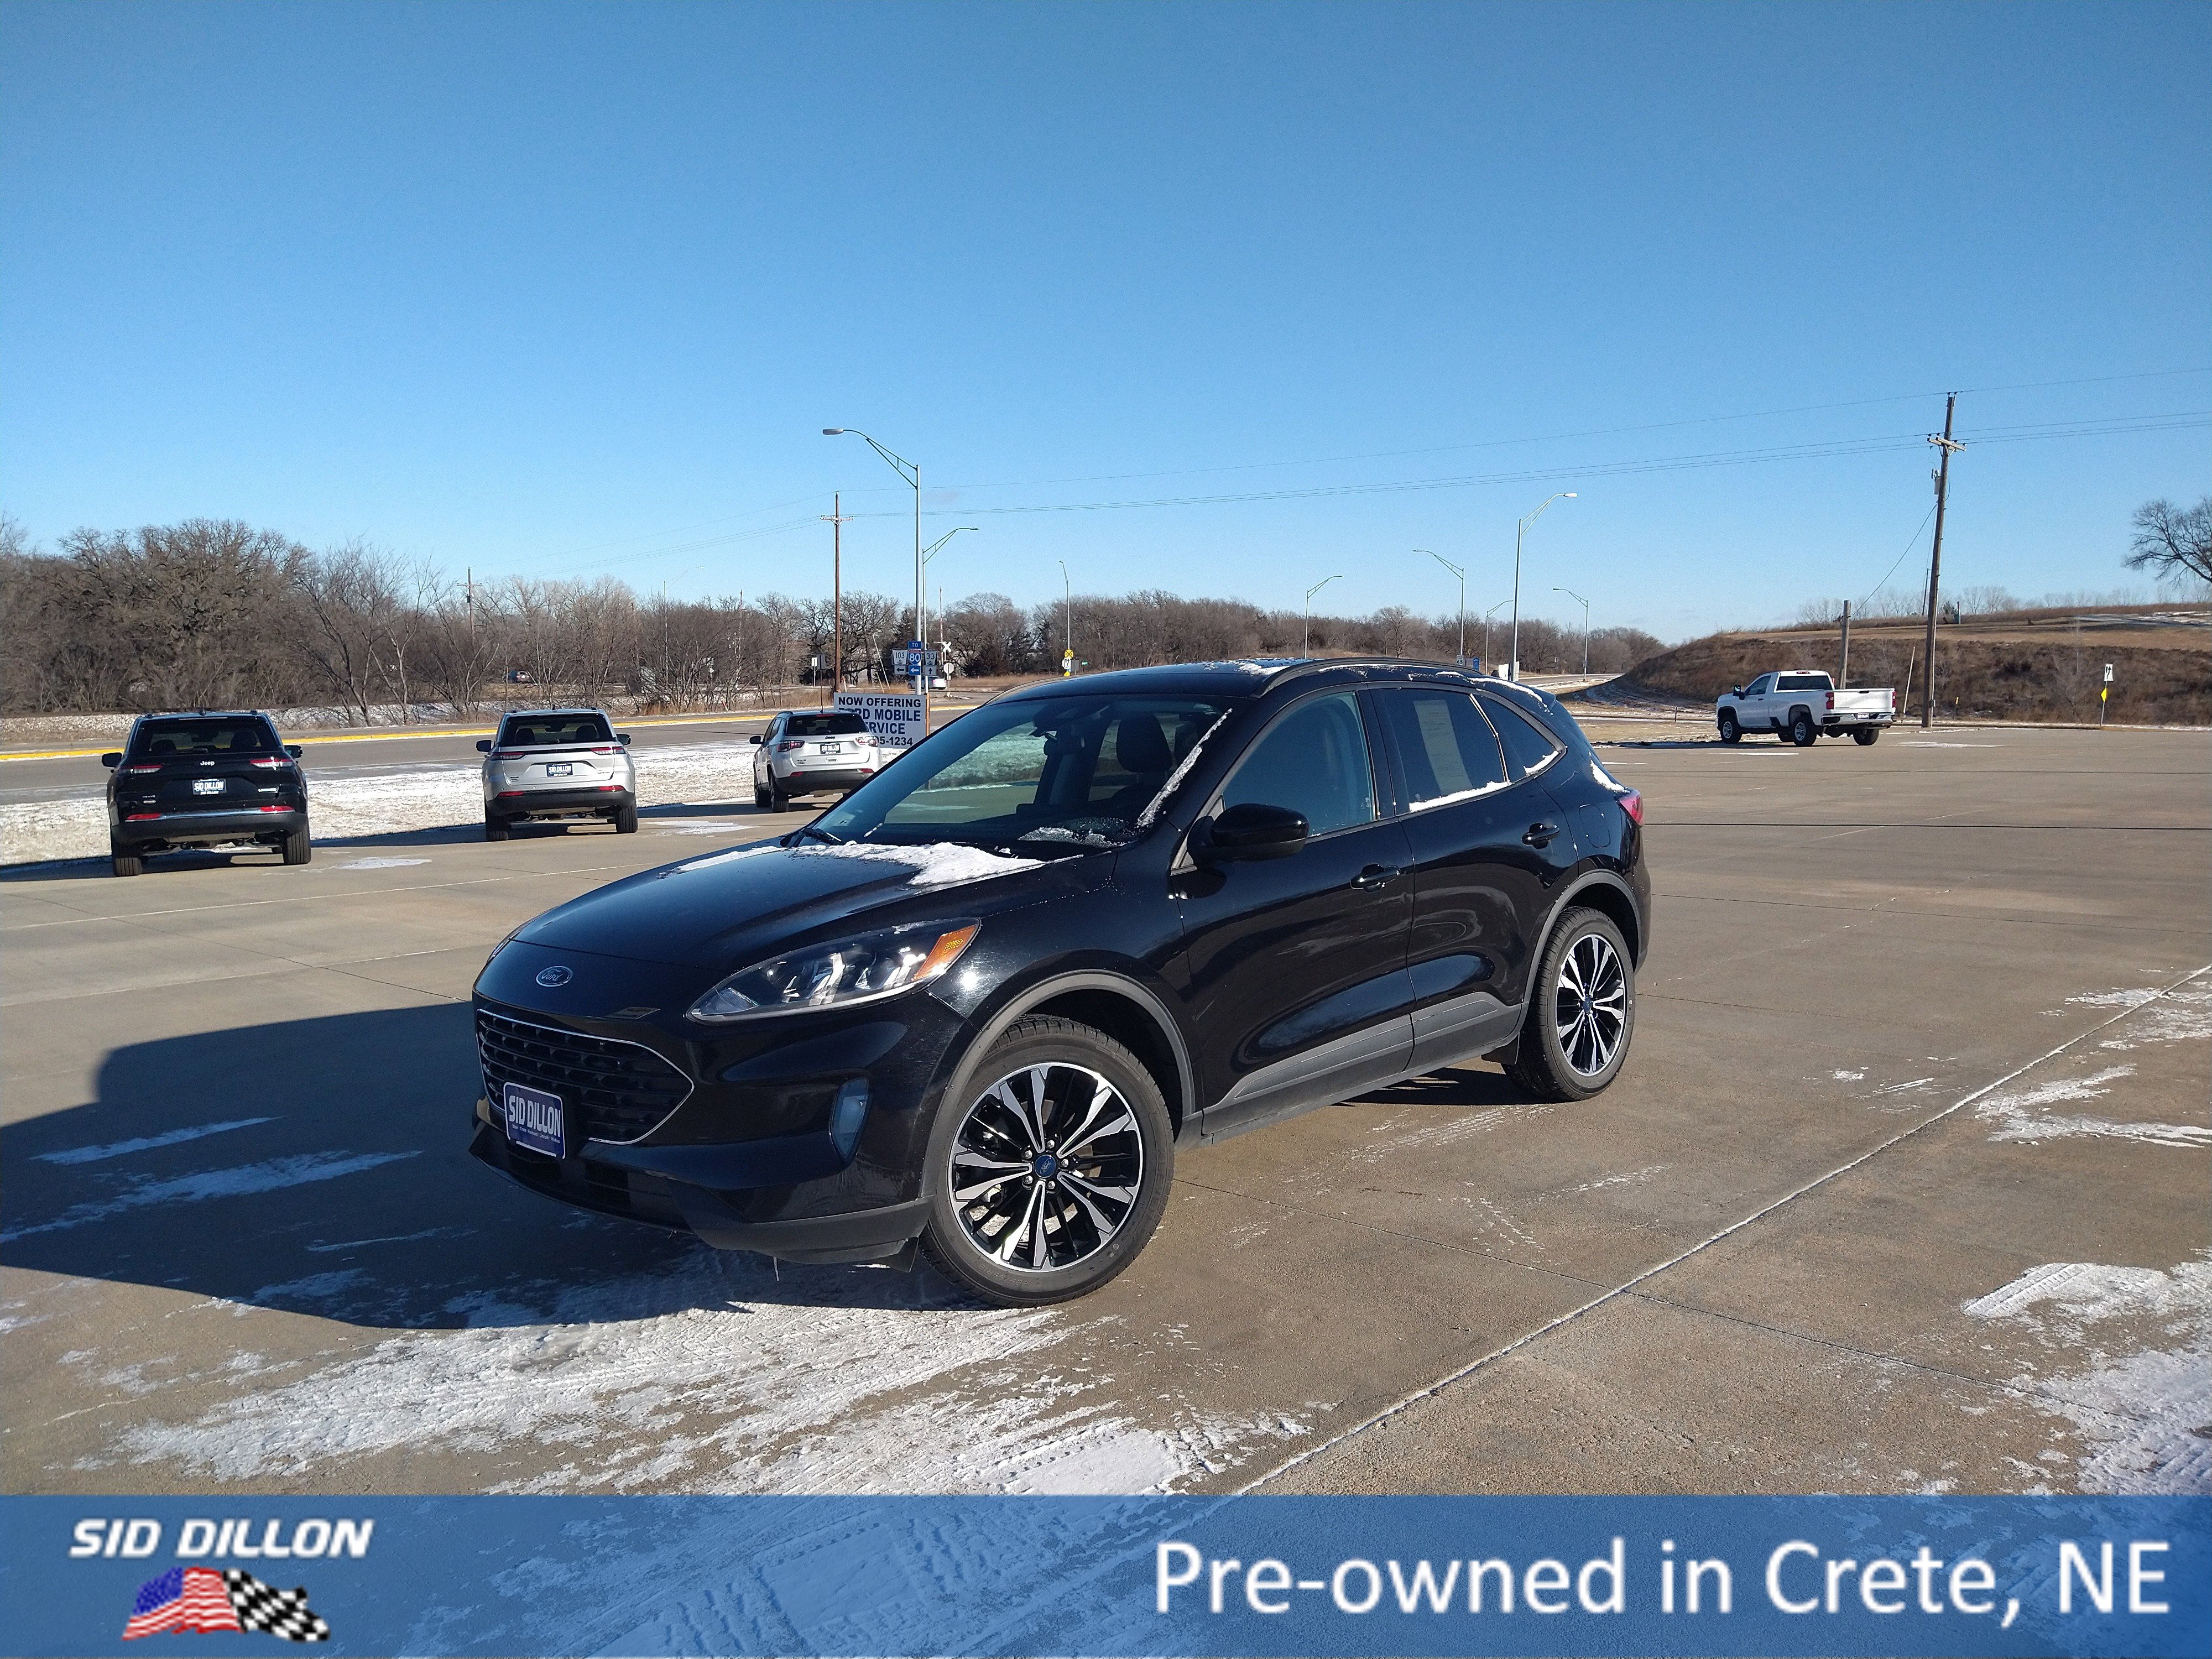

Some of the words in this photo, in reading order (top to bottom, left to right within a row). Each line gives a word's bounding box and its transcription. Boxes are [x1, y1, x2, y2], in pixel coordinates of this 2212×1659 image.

[910, 653, 921, 662] 80
[838, 696, 863, 706] NOW
[866, 697, 921, 708] OFFERING
[838, 708, 870, 719] RD
[874, 708, 921, 722] MOBILE
[864, 722, 905, 734] RVICE
[194, 782, 204, 790] SID
[204, 781, 224, 790] DILLON
[509, 1095, 525, 1125] SID
[527, 1099, 561, 1138] DILLON
